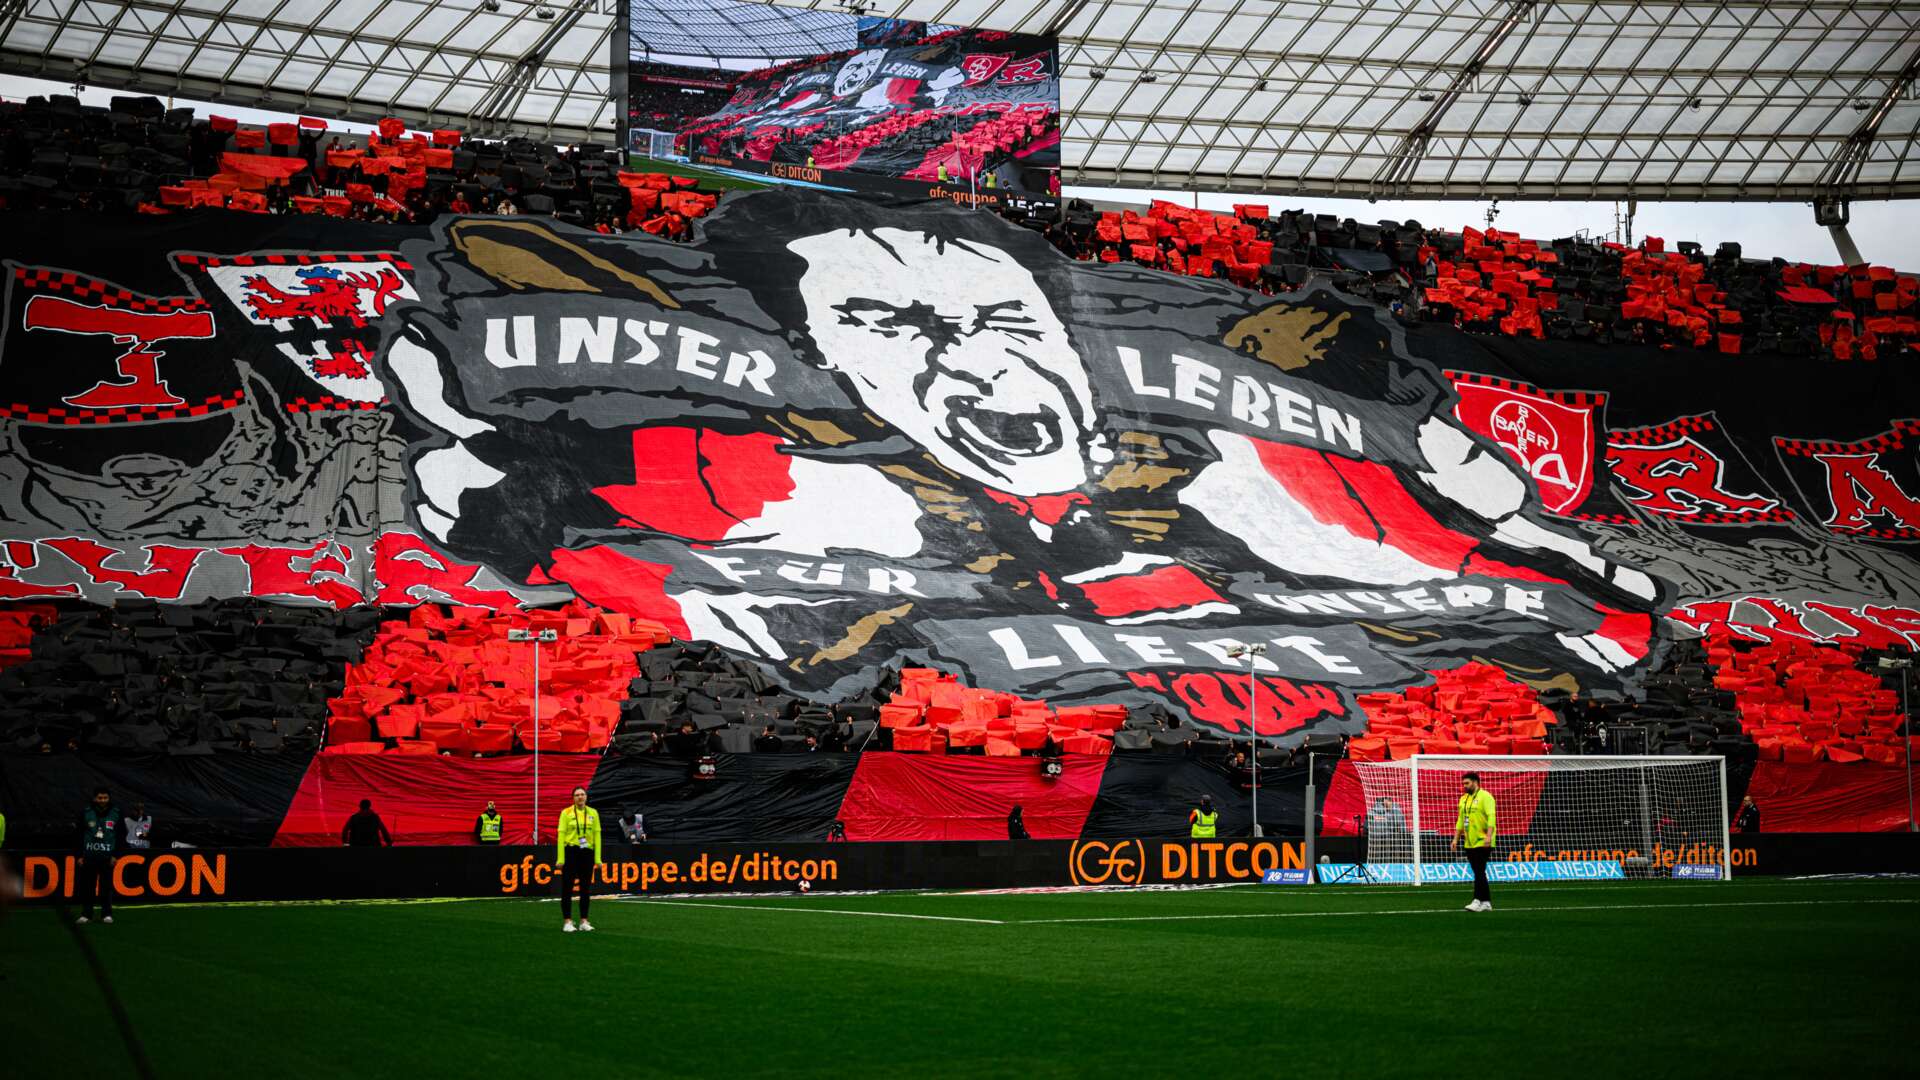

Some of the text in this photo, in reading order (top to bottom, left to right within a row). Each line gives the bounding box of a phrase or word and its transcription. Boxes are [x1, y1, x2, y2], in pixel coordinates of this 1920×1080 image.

[788, 166, 822, 182] DITCON
[485, 315, 775, 396] UNSER
[1116, 346, 1364, 453] LEBEN
[24, 854, 226, 898] DICON
[500, 852, 838, 892] gfc-ruppe.de/ditcon
[1162, 842, 1306, 879] DITCON
[1553, 861, 1622, 879] NIEDAX
